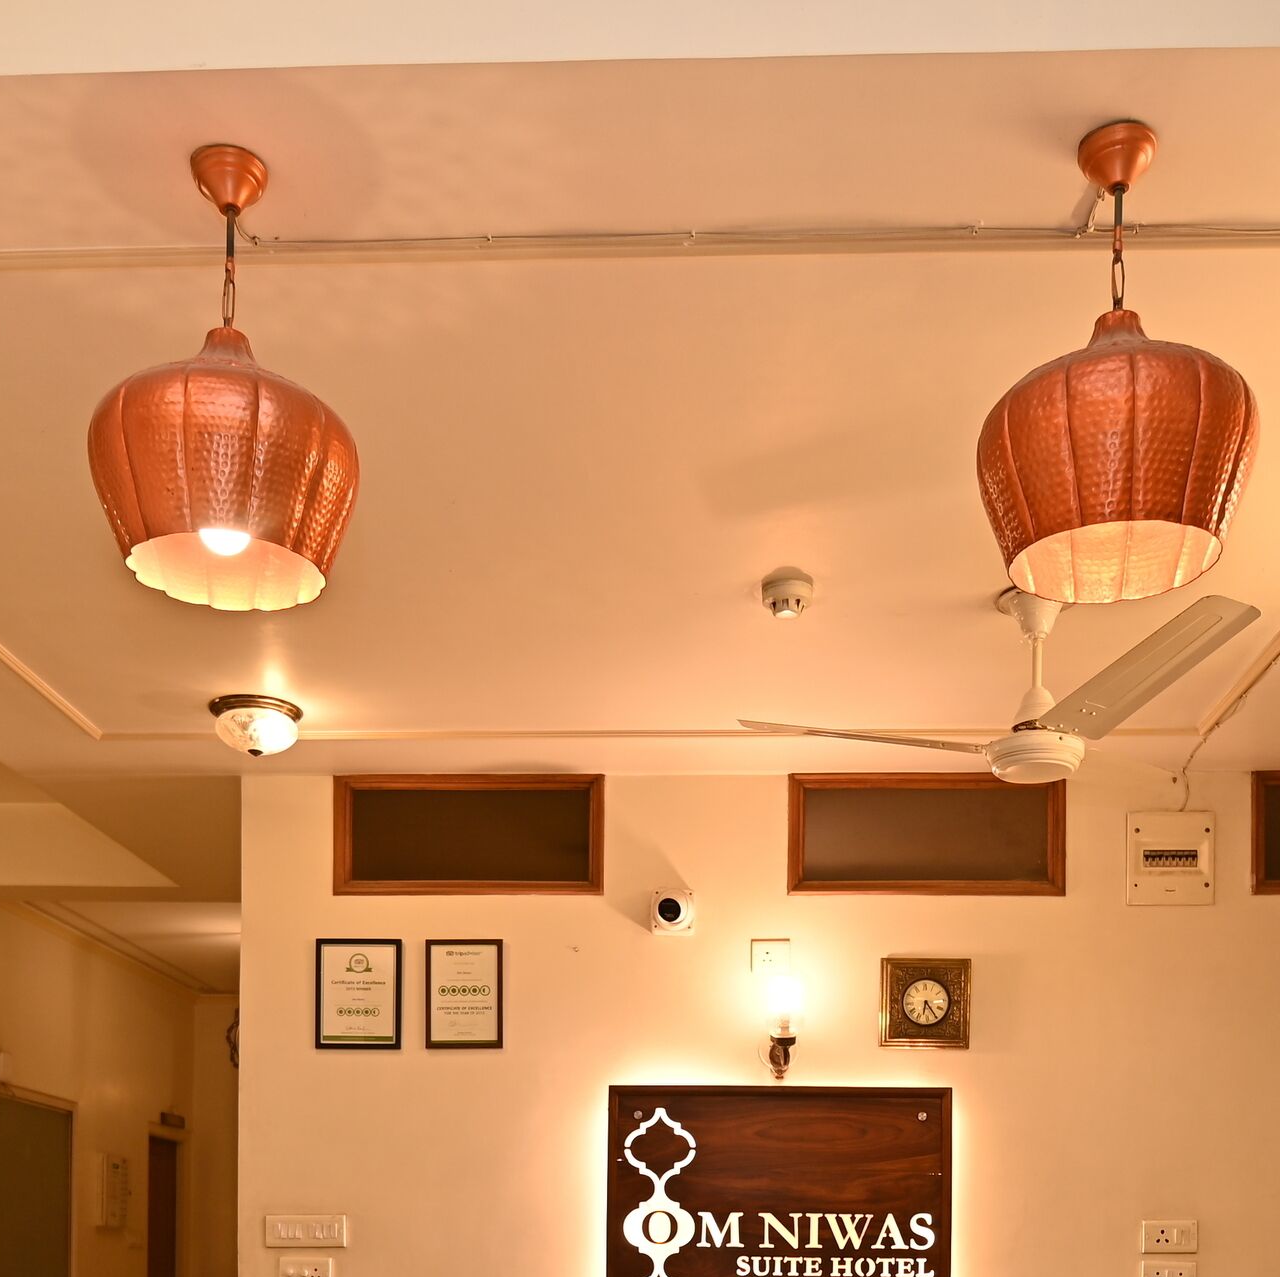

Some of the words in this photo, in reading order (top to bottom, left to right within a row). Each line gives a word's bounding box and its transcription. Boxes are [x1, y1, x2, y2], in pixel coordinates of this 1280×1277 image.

[642, 1210, 744, 1248] OM
[758, 1212, 936, 1251] NIWAS
[736, 1255, 823, 1277] SUITE
